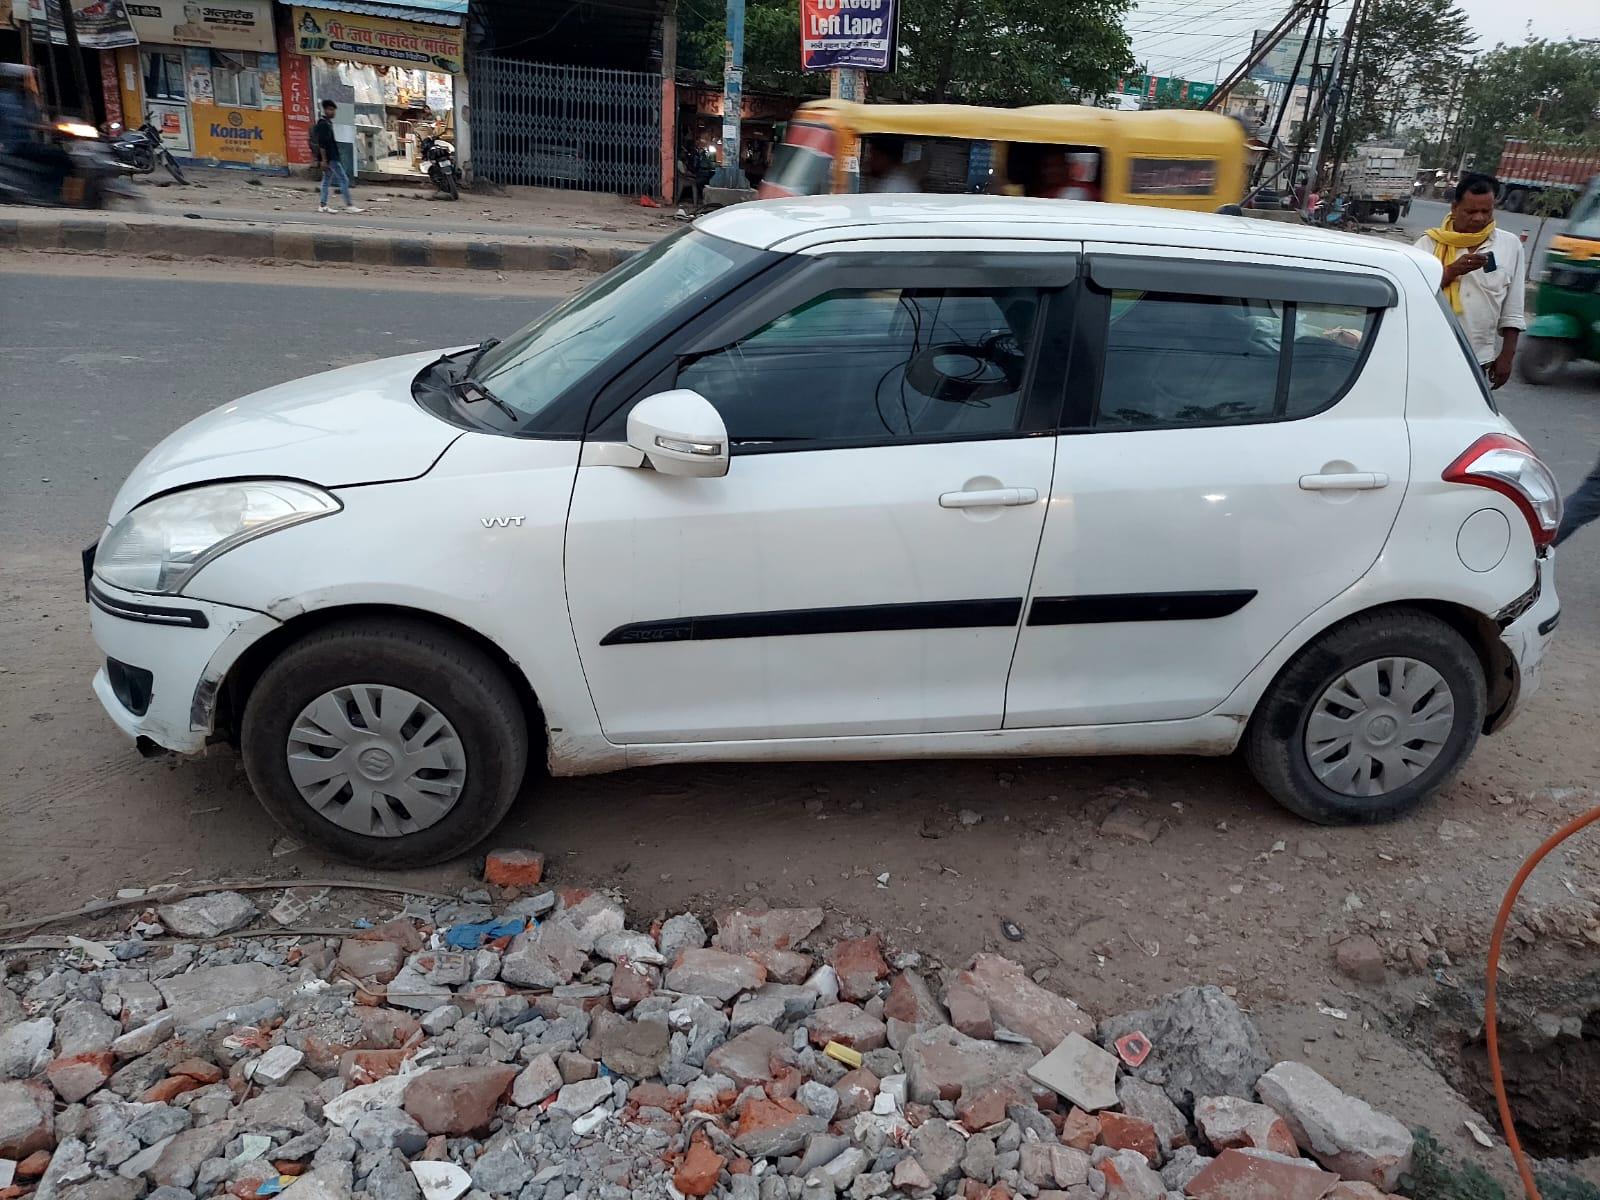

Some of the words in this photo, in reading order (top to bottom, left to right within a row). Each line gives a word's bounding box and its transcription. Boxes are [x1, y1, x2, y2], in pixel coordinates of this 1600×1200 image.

[811, 14, 840, 36] Left
[843, 14, 883, 35] Lane
[350, 28, 373, 44] जय
[377, 31, 419, 50] महादेव
[210, 123, 264, 140] Konark
[480, 515, 526, 529] VVT
